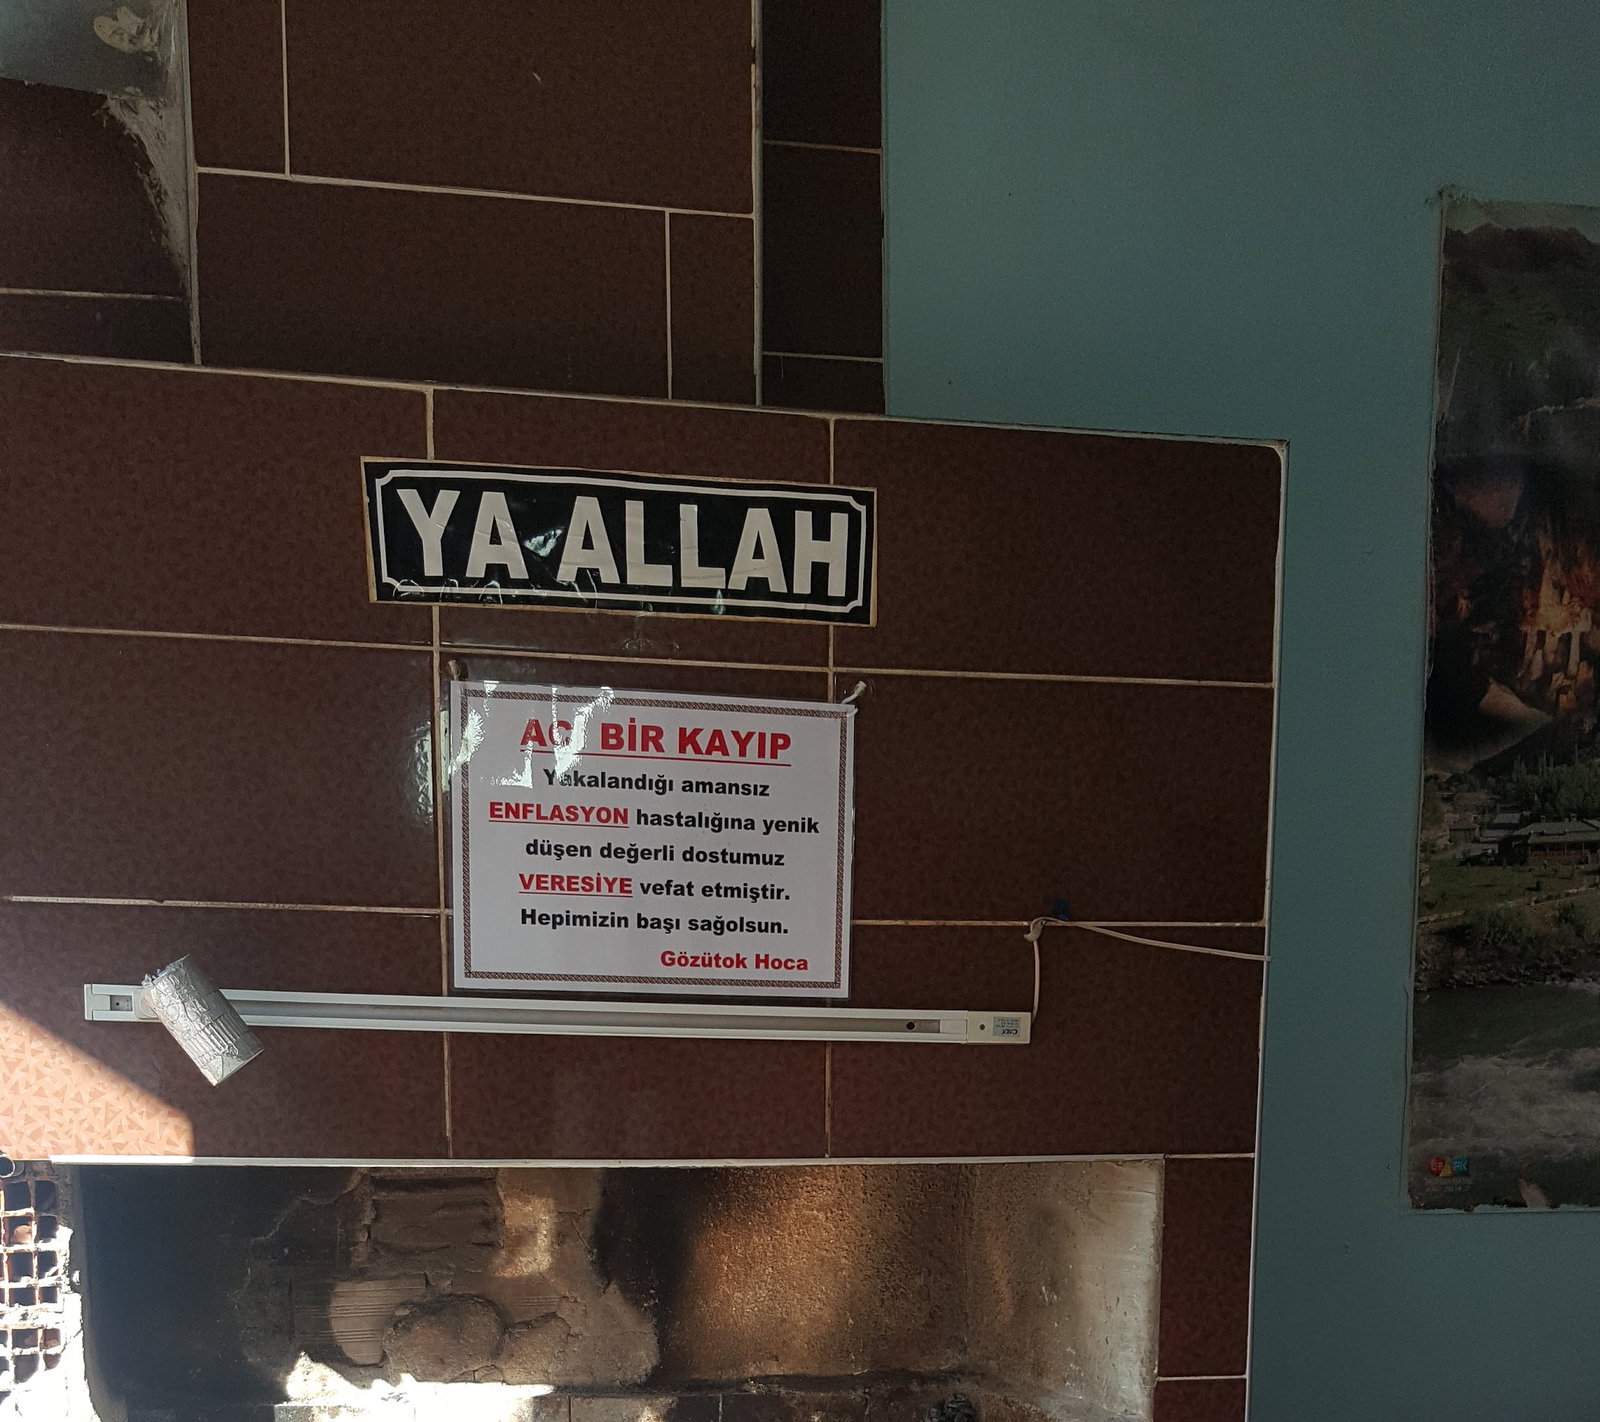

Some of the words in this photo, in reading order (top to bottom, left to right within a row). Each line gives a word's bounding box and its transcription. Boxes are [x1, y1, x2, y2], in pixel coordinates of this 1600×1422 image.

[397, 489, 529, 580] YA
[557, 495, 849, 597] ALLAH
[520, 717, 586, 751] AC
[601, 717, 665, 753] BİR
[678, 727, 792, 760] KAYIP
[543, 768, 674, 796] Yakalandığı
[682, 780, 769, 796] amansız
[489, 801, 629, 824] ENFLASYON
[637, 809, 755, 833] hastalığına
[763, 817, 819, 835] yenik
[526, 839, 591, 860] düşen
[600, 843, 674, 864] değerli
[682, 846, 784, 866] dostumuz
[519, 873, 632, 894] VERESİYE
[640, 880, 694, 896] vefat
[702, 882, 789, 903] etmiştir.
[521, 909, 628, 929] Hepimizin
[637, 913, 680, 934] başı
[688, 916, 788, 936] sağolsun.
[660, 951, 746, 968] Gözütok
[755, 954, 808, 970] Hoca
